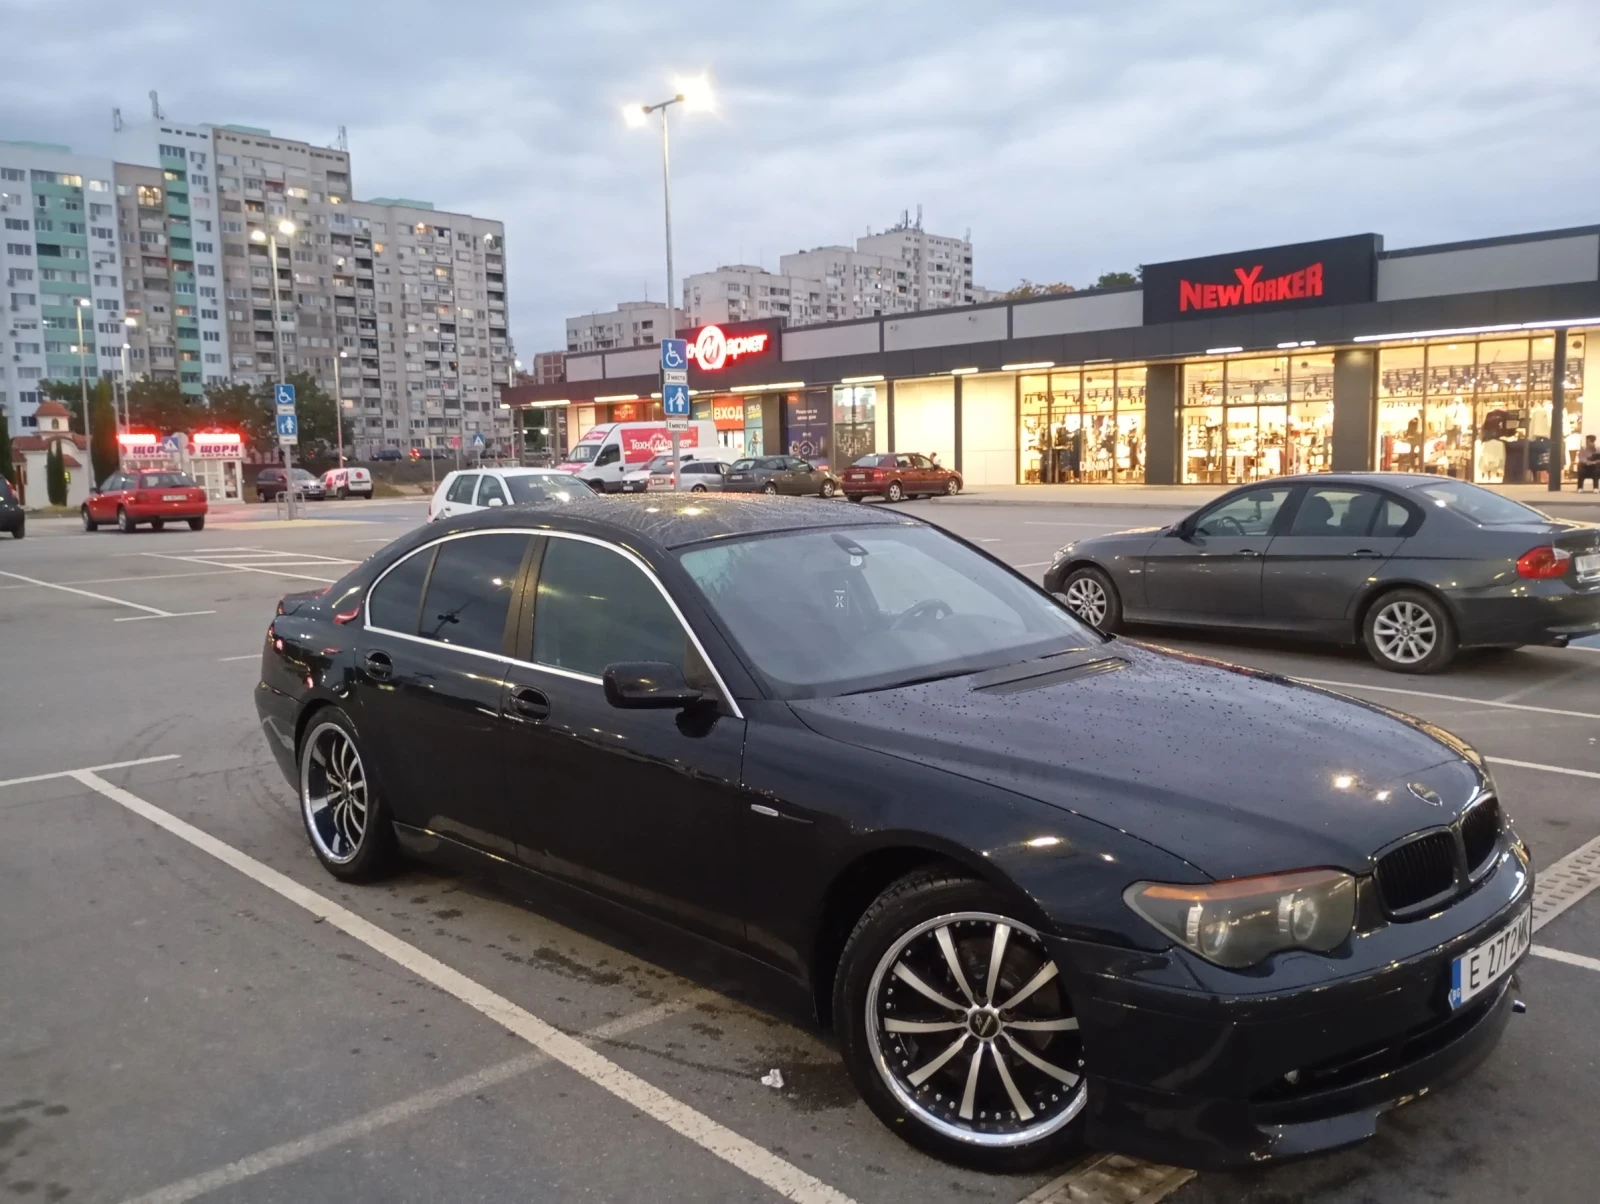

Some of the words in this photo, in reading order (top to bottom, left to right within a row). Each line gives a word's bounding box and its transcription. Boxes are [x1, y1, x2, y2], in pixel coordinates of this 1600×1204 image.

[714, 406, 743, 420] ВХОД
[133, 446, 163, 454] ЩОР
[200, 445, 239, 453] ЩОРИ
[1470, 954, 1480, 989] E
[1452, 988, 1461, 1001] BG
